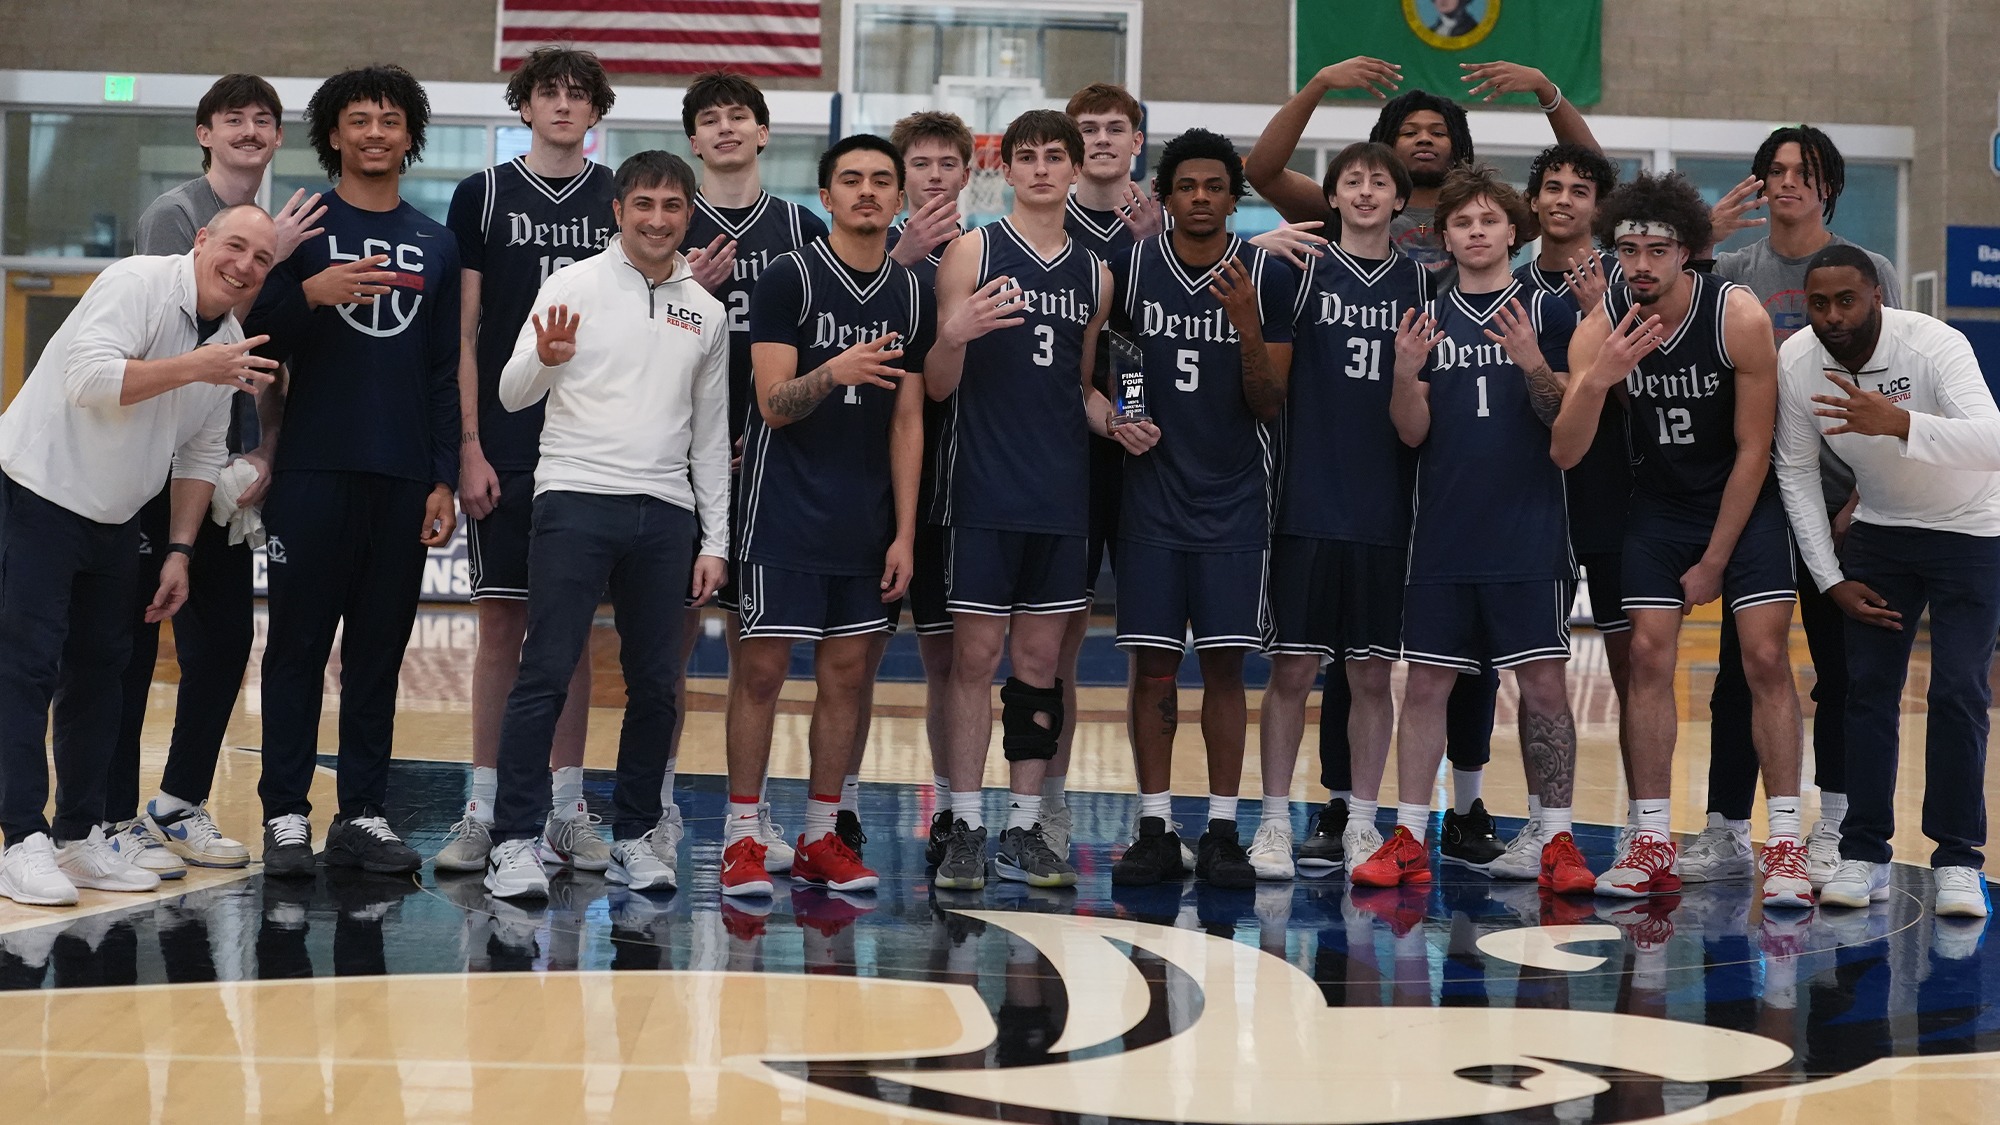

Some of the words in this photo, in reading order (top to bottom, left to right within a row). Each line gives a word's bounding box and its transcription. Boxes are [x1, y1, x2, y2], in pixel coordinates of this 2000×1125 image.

[506, 212, 609, 250] Devils
[328, 235, 424, 272] LCC
[667, 303, 702, 325] LCC
[667, 317, 680, 327] RED
[680, 321, 701, 335] DEVILS
[728, 290, 750, 332] 2
[1315, 291, 1404, 333] Devil
[1033, 324, 1054, 367] 3
[1344, 336, 1382, 381] 31
[1121, 372, 1144, 380] FINAL
[1122, 378, 1143, 386] FOUR
[1175, 349, 1200, 392] 5
[1626, 363, 1720, 399] Devils
[1877, 376, 1911, 396] LCC
[1476, 375, 1490, 417] 1
[1655, 407, 1695, 444] 12
